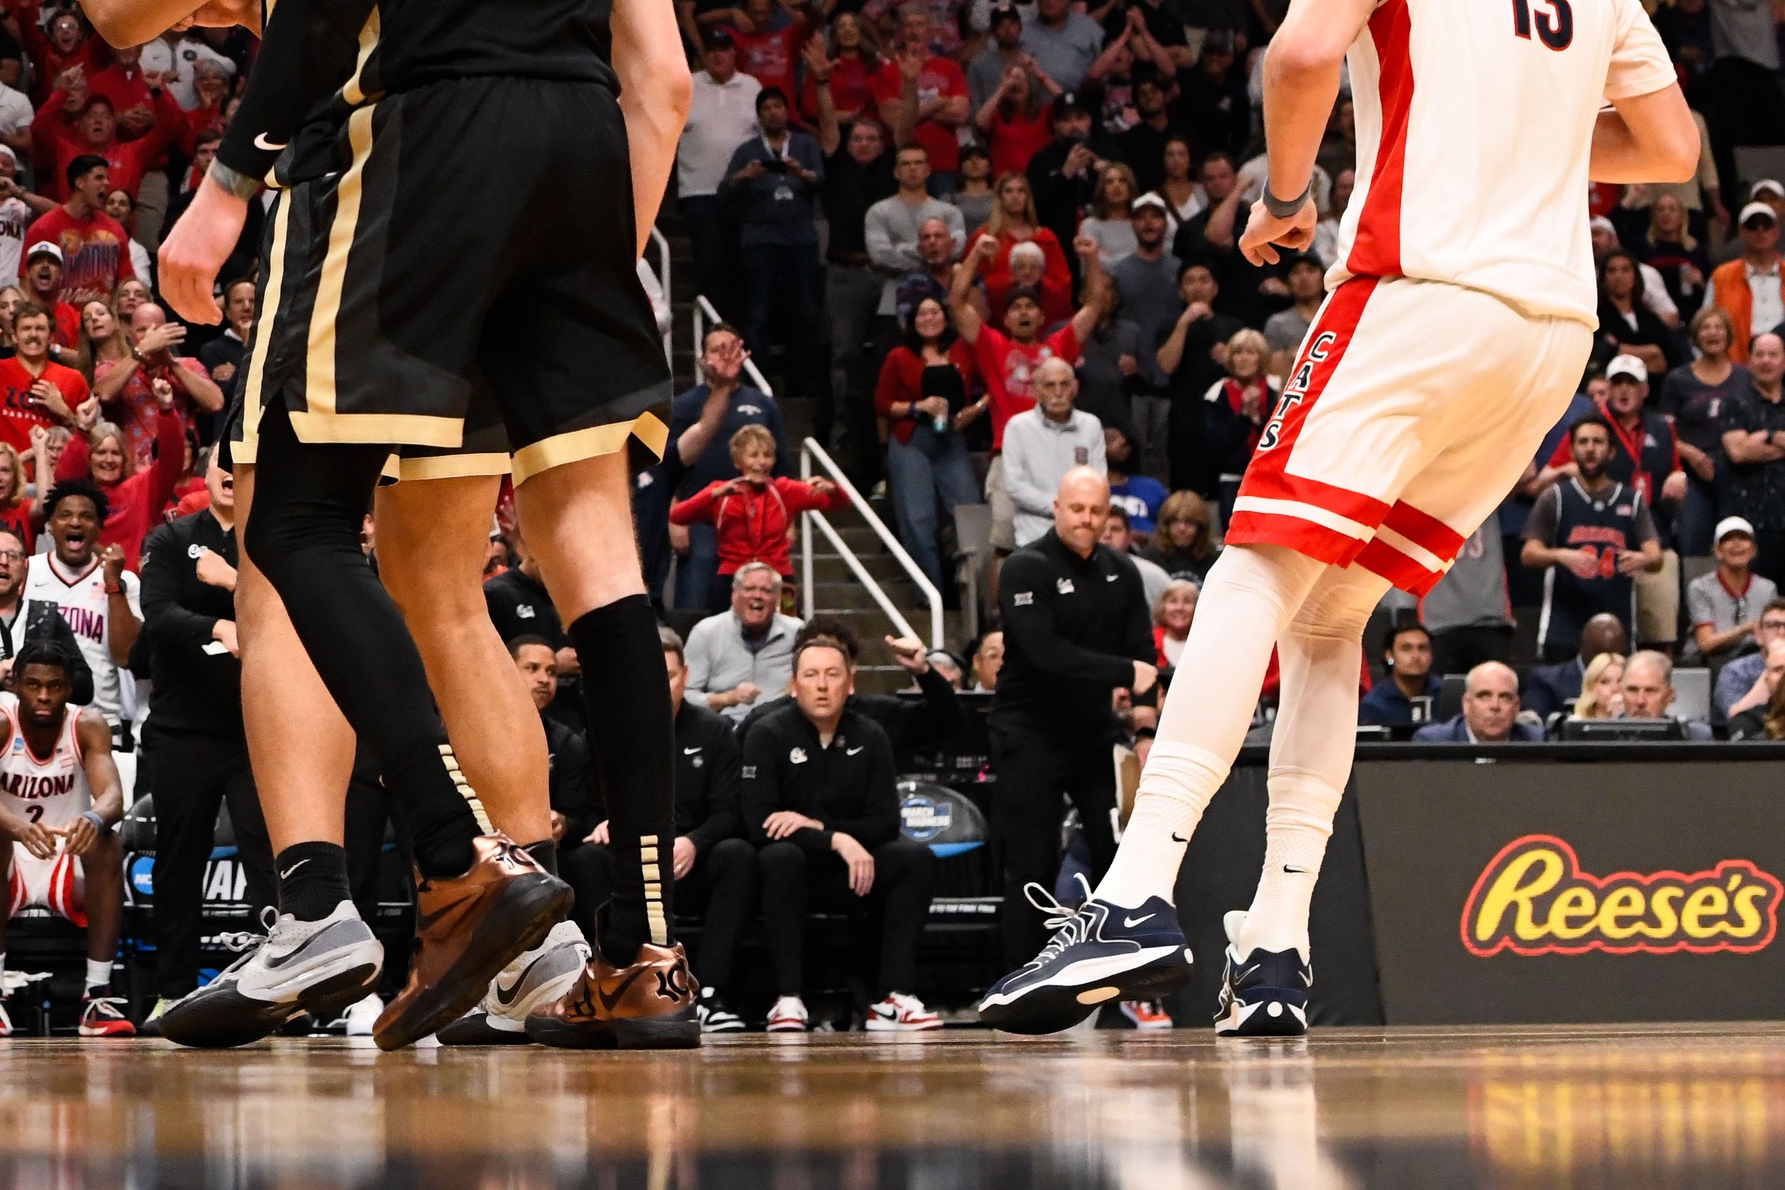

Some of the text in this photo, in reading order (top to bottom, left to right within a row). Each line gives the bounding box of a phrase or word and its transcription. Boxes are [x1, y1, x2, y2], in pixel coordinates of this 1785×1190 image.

[1256, 330, 1338, 452] CATS
[57, 606, 105, 645] ZONA
[0, 773, 75, 800] ARIZONA
[1475, 847, 1767, 942] Reese's
